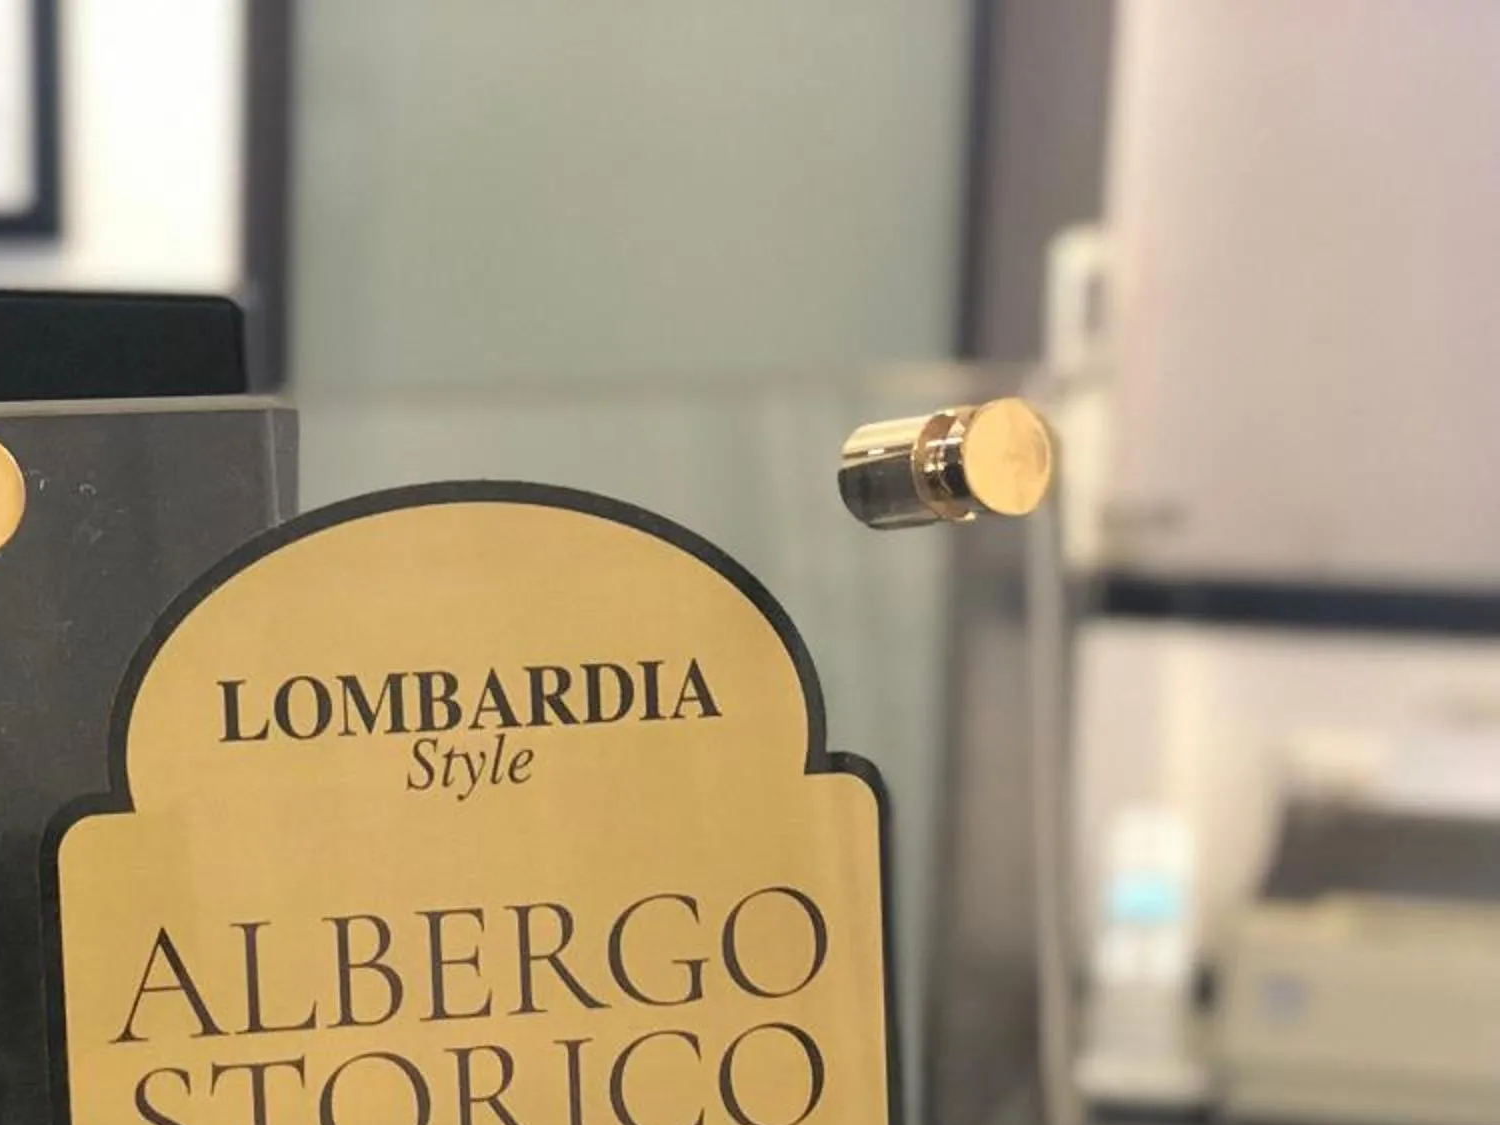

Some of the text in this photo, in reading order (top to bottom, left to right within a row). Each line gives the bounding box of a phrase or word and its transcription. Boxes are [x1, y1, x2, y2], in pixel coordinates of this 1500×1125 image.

[217, 657, 722, 743] LOMBARDIA
[406, 733, 536, 801] Style
[109, 886, 828, 1045] ALBERGO
